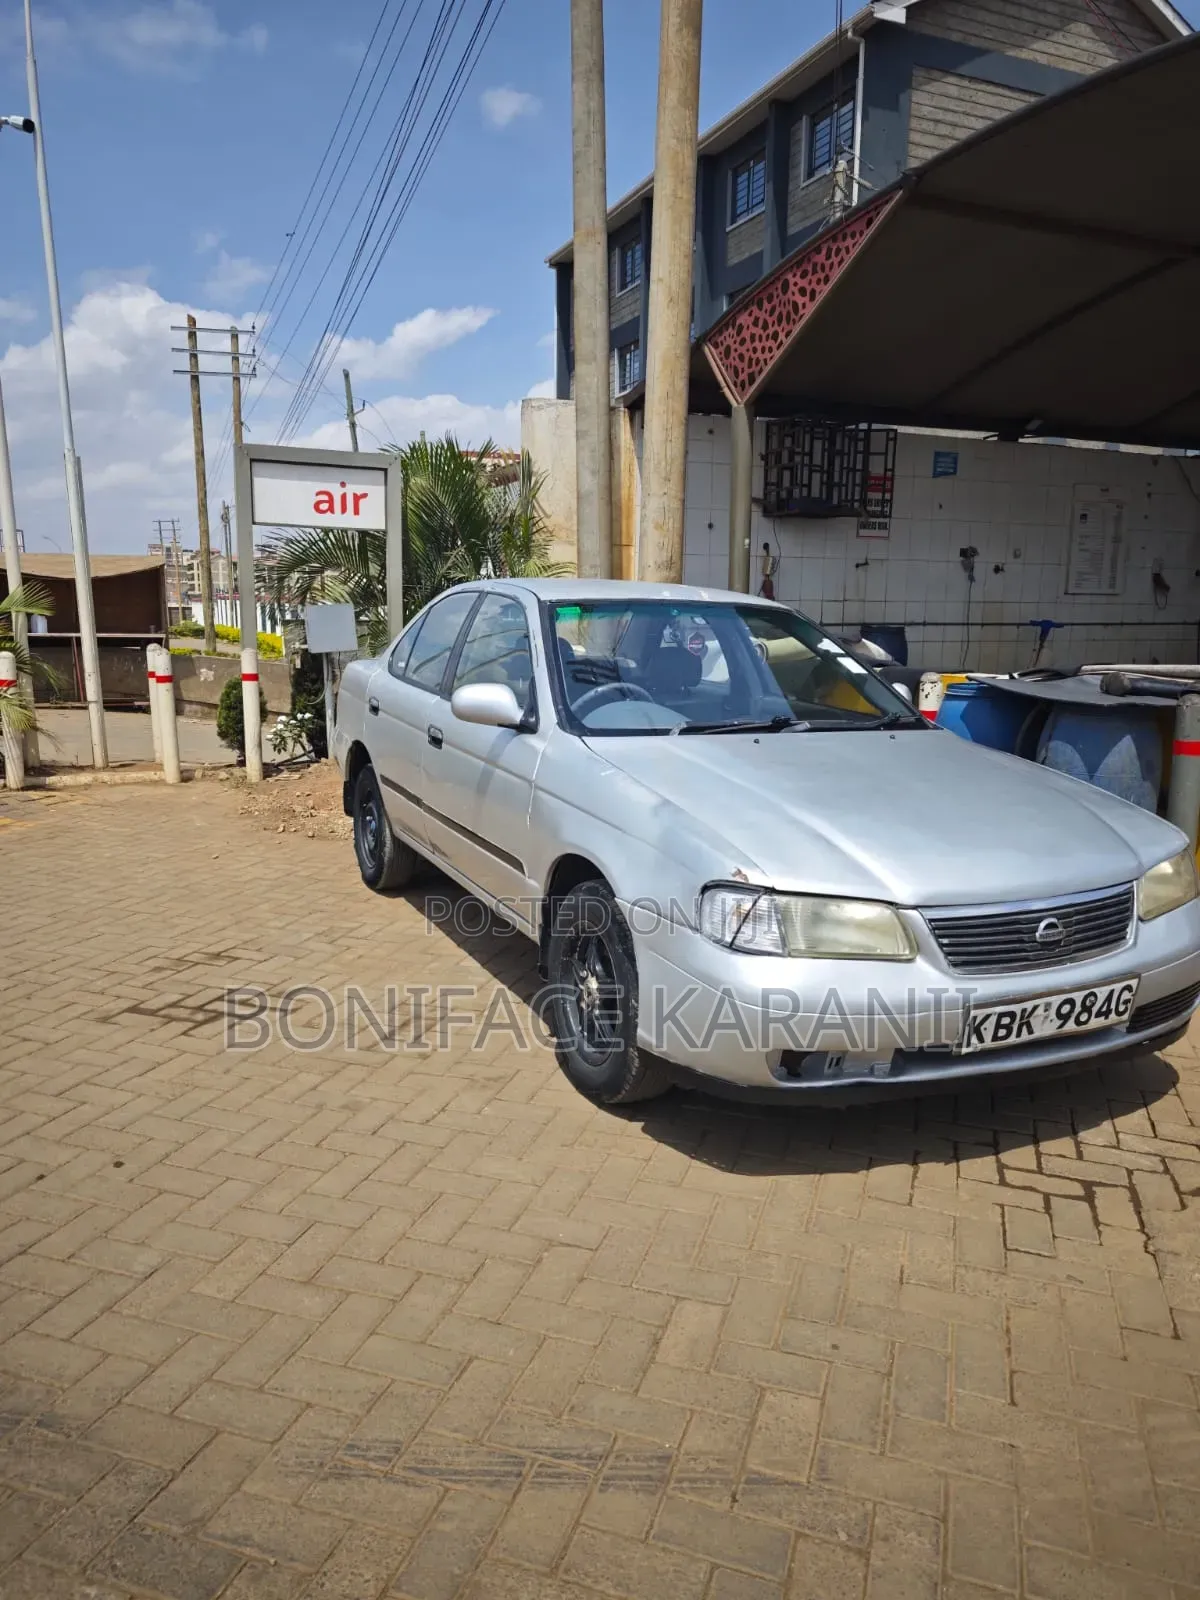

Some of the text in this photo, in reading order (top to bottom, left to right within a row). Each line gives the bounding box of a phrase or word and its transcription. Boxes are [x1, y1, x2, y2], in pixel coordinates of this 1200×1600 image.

[313, 481, 369, 516] air
[965, 983, 1135, 1049] KBK 984G
